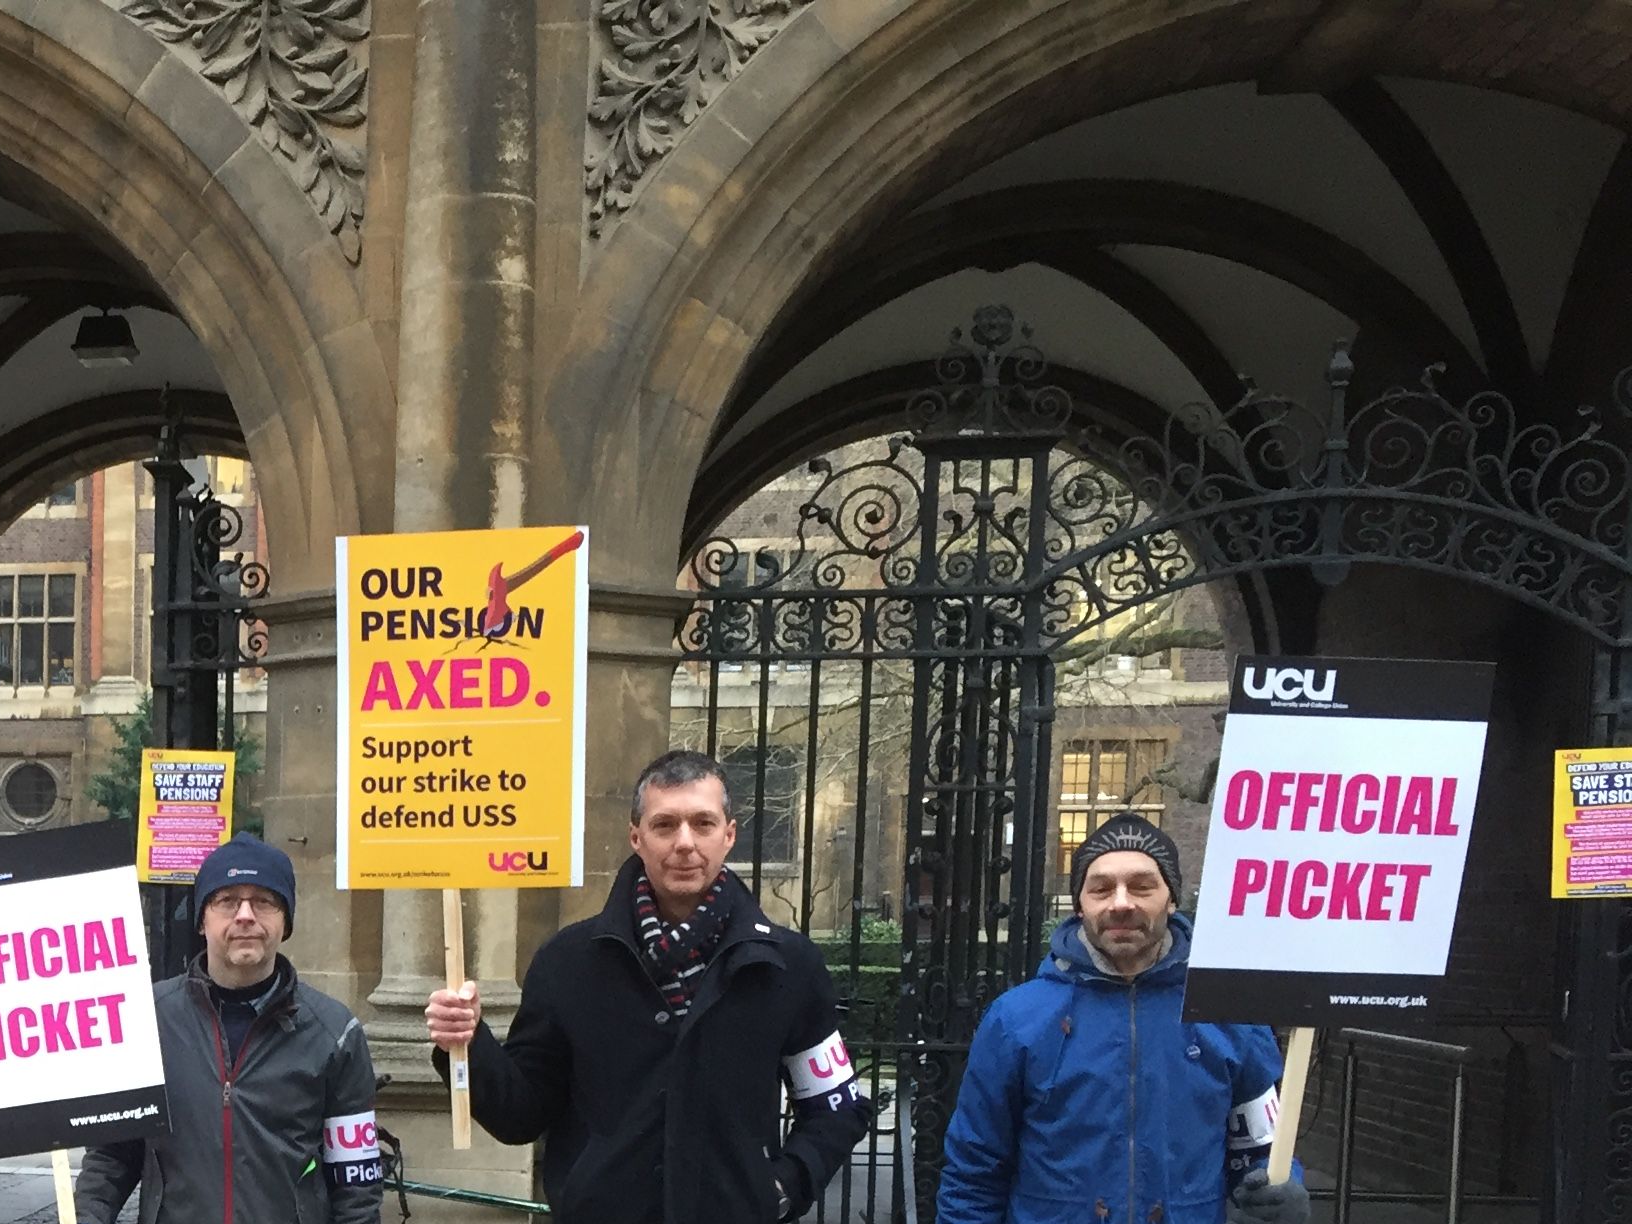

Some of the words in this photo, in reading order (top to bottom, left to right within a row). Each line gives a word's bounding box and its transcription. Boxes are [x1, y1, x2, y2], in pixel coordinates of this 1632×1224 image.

[360, 565, 443, 600] OUR
[360, 606, 545, 642] PENSION
[360, 657, 551, 712] AXED.
[361, 735, 473, 763] Support
[154, 773, 184, 787] SAVE
[187, 774, 223, 787] STAFF
[360, 774, 407, 794] our
[413, 768, 491, 793] strike
[498, 770, 527, 792] to
[1572, 775, 1609, 790] SAVE
[159, 787, 218, 801] PENSIONS
[1223, 769, 1460, 837] OFFICIAL
[1579, 789, 1632, 805] PENSIO
[360, 804, 455, 829] defend
[463, 803, 517, 828] USS
[1228, 858, 1433, 922] PICKET
[1330, 993, 1428, 1008] www.ucu.org.uk
[70, 1104, 159, 1128] www.ucu.org.uk
